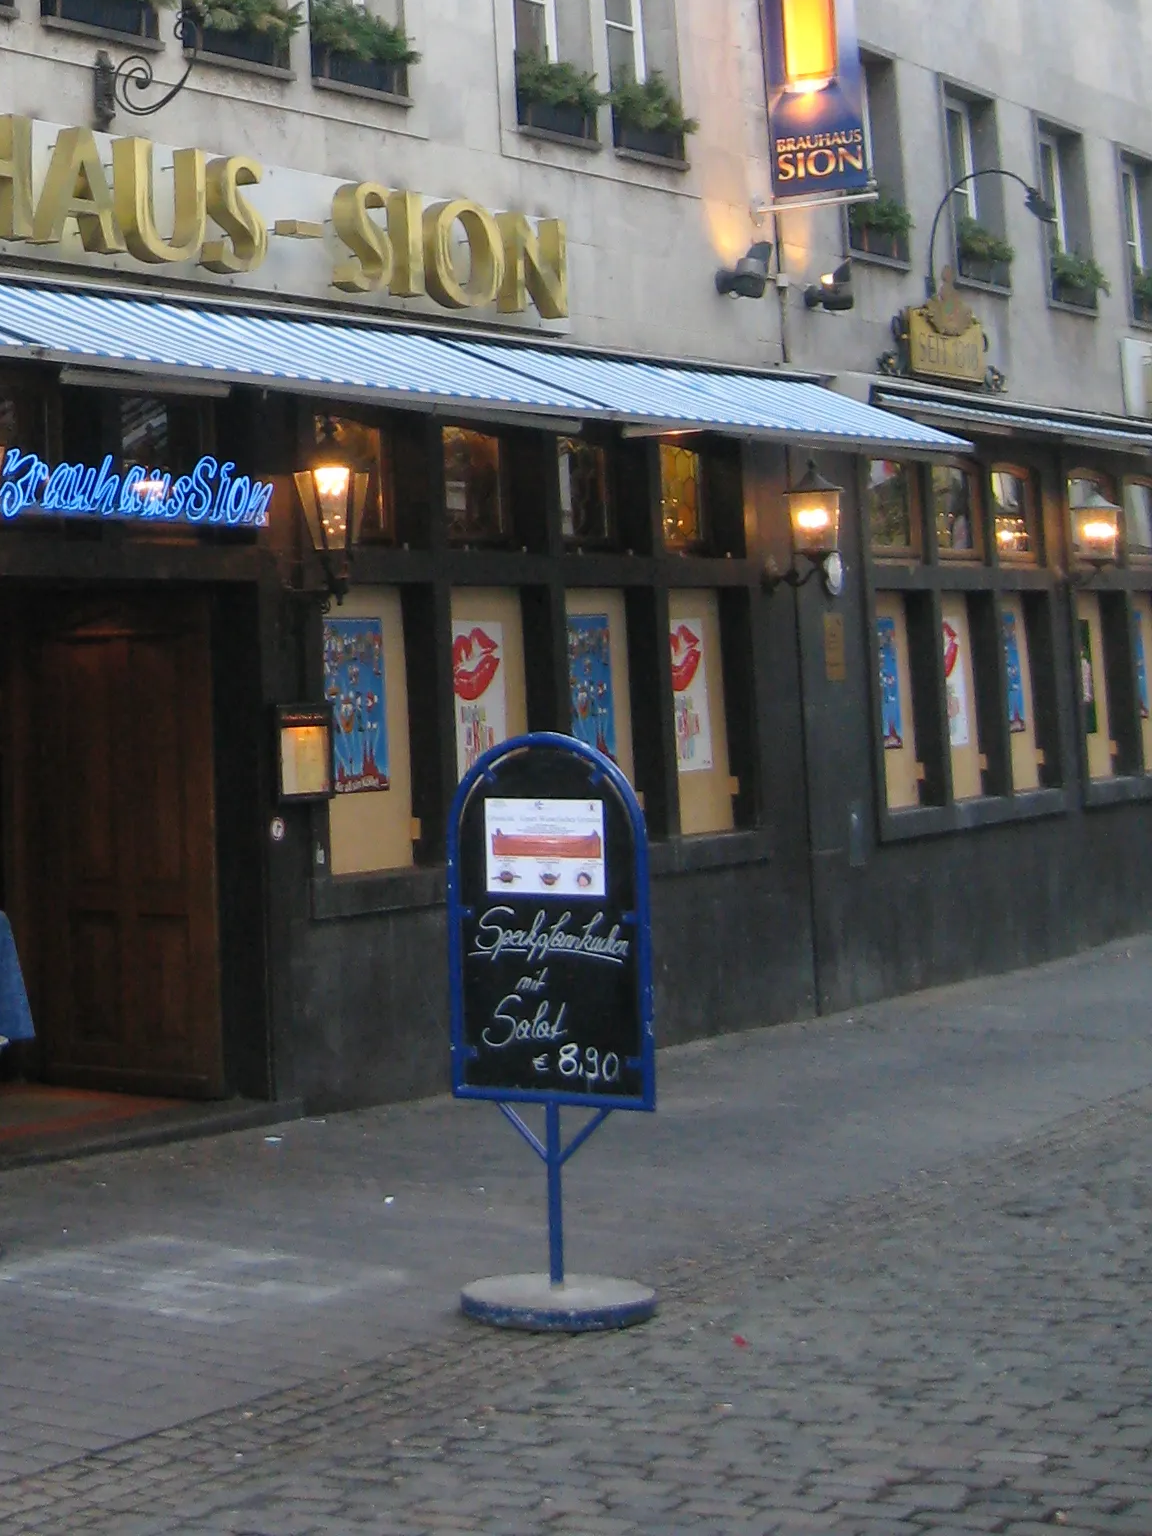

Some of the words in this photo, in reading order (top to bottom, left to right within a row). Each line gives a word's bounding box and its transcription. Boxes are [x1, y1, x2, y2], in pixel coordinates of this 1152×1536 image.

[776, 128, 863, 154] BRAUHAUS
[777, 144, 864, 183] SION
[515, 966, 549, 992] mit
[481, 993, 569, 1048] Salat
